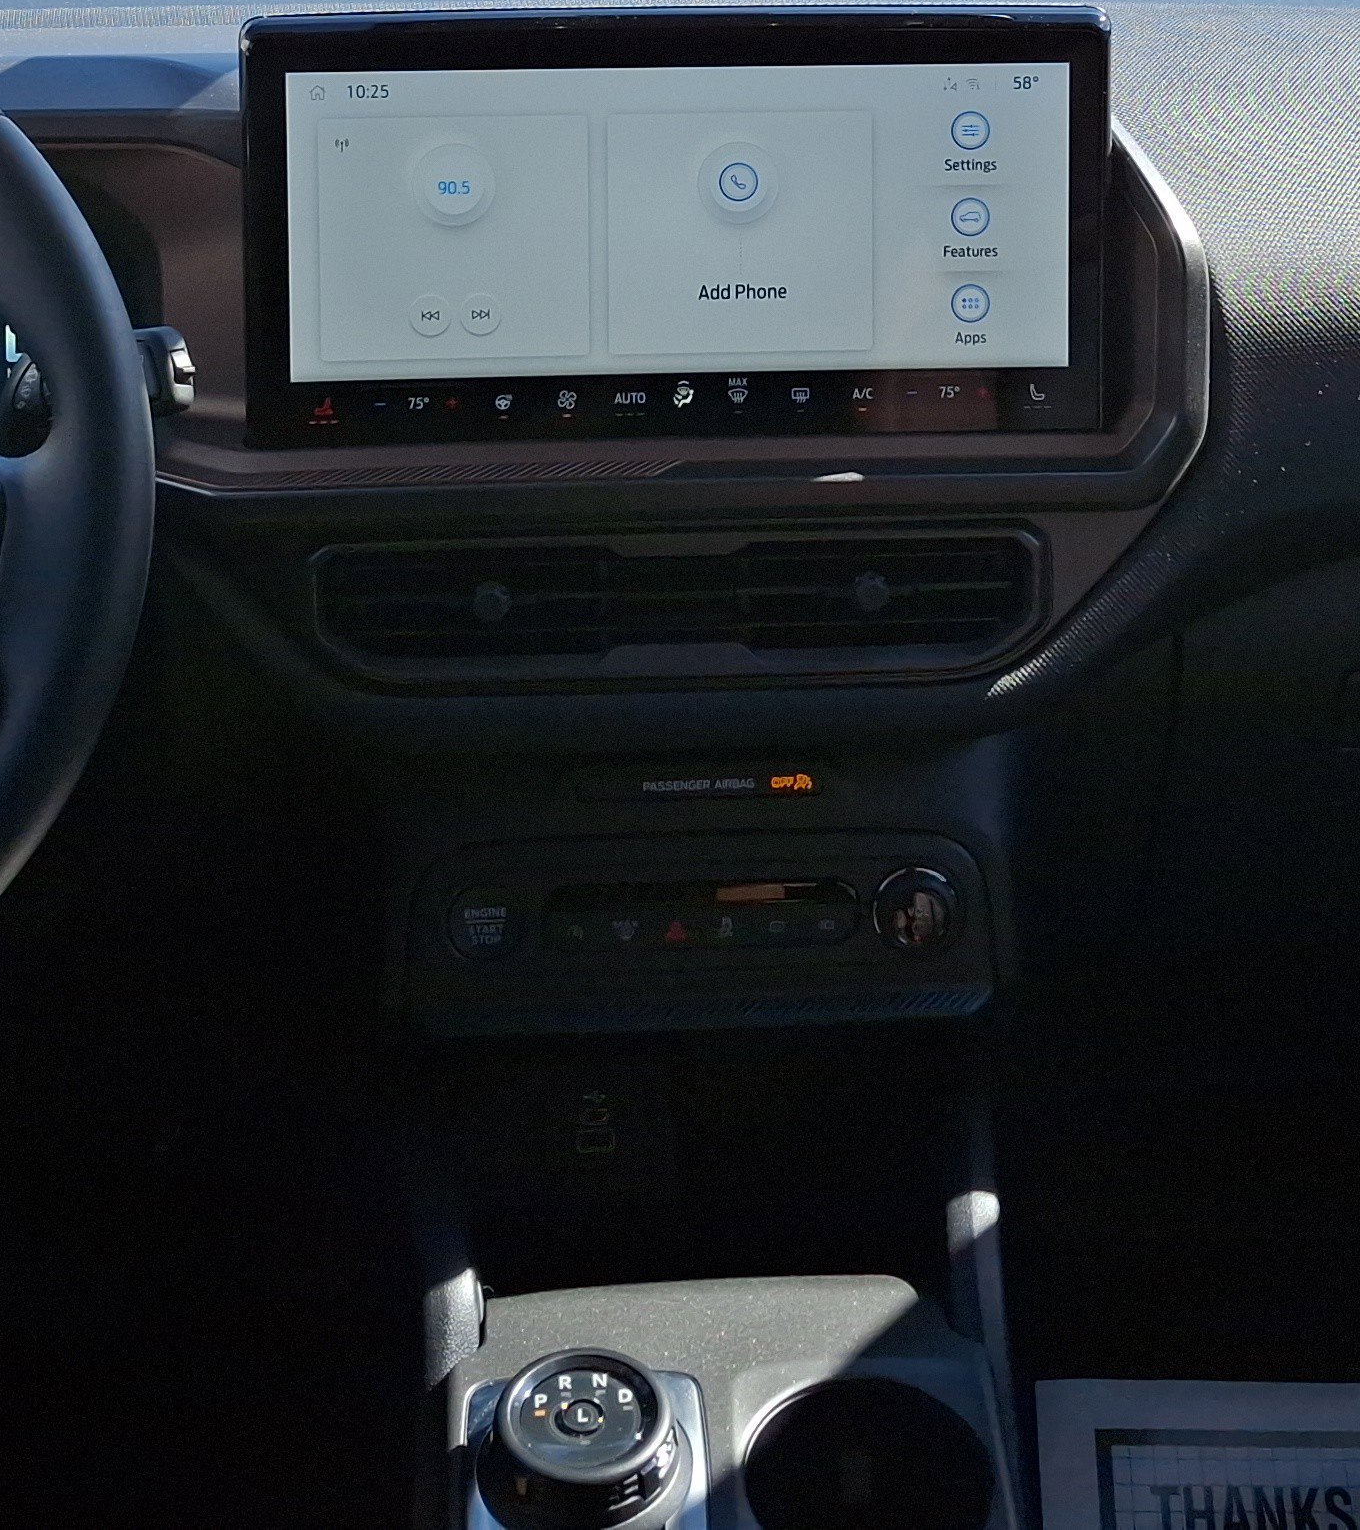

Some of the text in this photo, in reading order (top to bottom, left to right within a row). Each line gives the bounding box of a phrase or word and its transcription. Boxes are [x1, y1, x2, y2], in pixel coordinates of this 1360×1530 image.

[1012, 75, 1040, 91] 58°
[346, 84, 390, 99] 10:25
[944, 158, 998, 173] Settings
[437, 180, 471, 195] 90.5
[943, 245, 999, 258] Features
[698, 283, 788, 301] Add Phone
[955, 331, 987, 346] Apps
[728, 377, 748, 387] MAX
[614, 391, 646, 405] AUTO
[852, 387, 874, 400] A/C
[939, 386, 960, 399] 75°
[407, 396, 430, 410] 75°
[642, 780, 711, 792] PASSENGER
[714, 777, 755, 789] AIRBAG
[558, 1375, 572, 1390] R
[592, 1373, 608, 1388] N
[534, 1394, 547, 1409] P
[618, 1388, 633, 1404] D
[577, 1408, 589, 1423] L
[1150, 1484, 1353, 1530] THANKS
